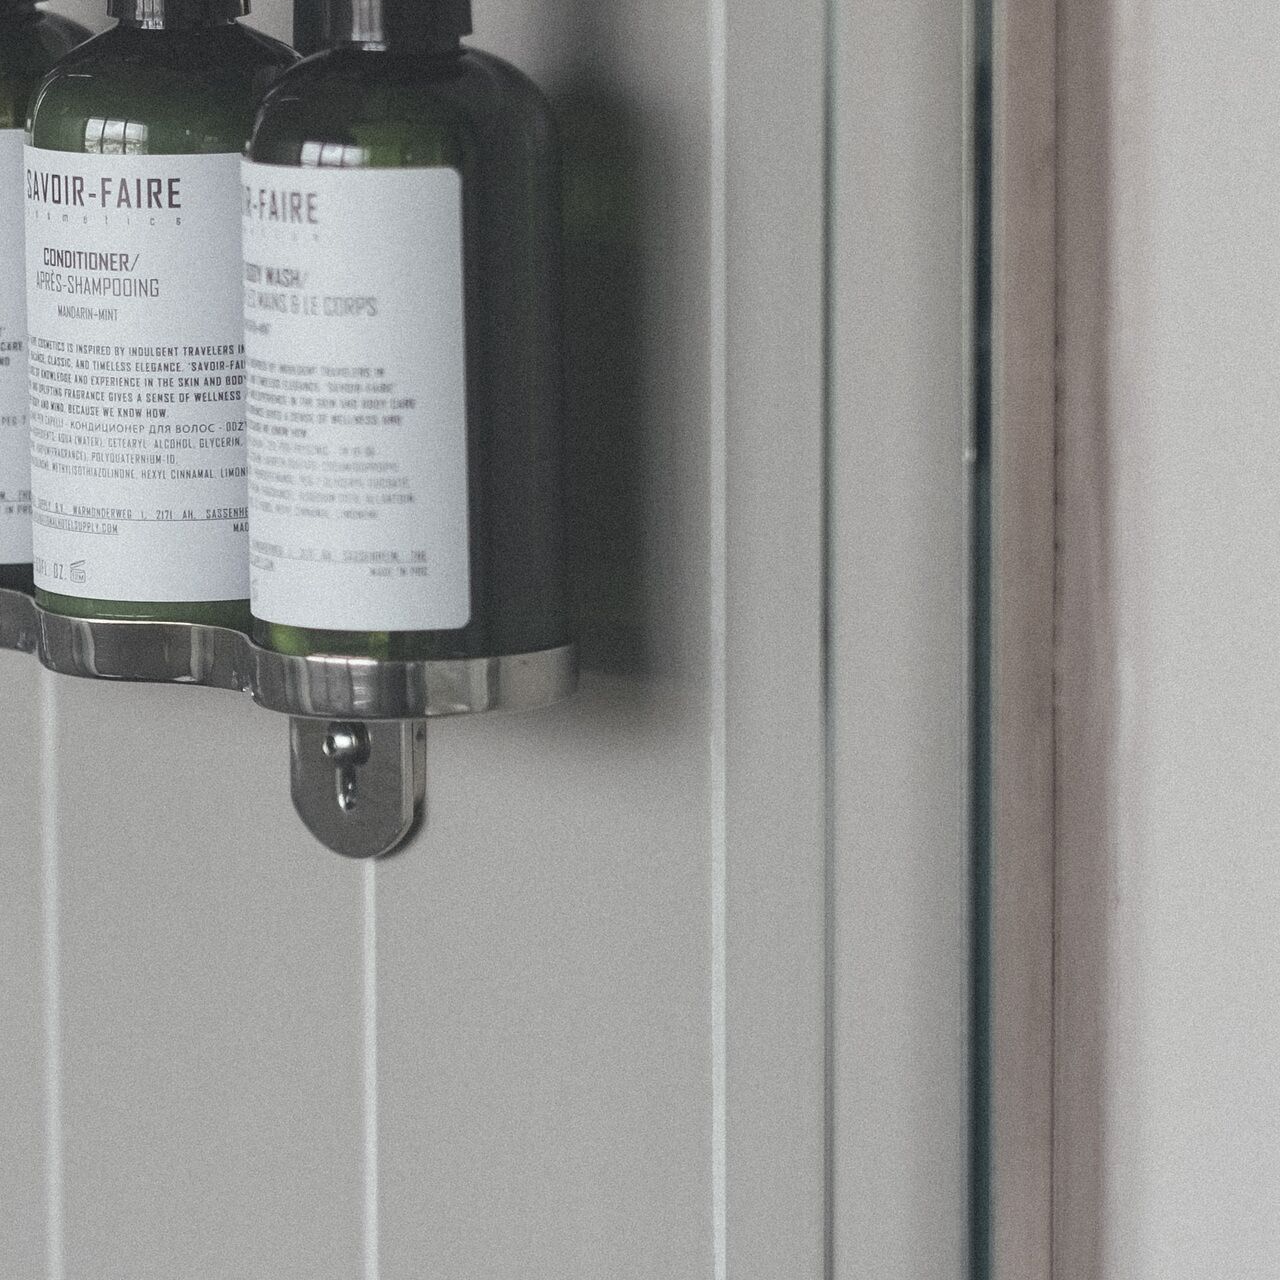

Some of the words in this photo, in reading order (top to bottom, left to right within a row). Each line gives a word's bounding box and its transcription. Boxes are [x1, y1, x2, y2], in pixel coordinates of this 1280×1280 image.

[26, 168, 182, 209] SAVOIR-FAIRE
[43, 247, 140, 272] CONDITIONER/
[36, 269, 160, 297] APRÈS-SHAMPOOING
[57, 305, 119, 321] MANDARIN-MINT
[76, 343, 111, 356] INSPIRED
[114, 346, 125, 356] BY
[128, 346, 178, 357] INDULGENT
[183, 344, 234, 356] TRAVELERS
[75, 359, 90, 370] AND
[92, 360, 132, 372] TIMELESS
[74, 374, 88, 385] AND
[90, 375, 141, 387] EXPERIENCE
[144, 377, 154, 387] IN
[157, 377, 174, 387] THE
[178, 377, 199, 387] SKIN
[203, 376, 222, 386] AND
[64, 388, 105, 401] FRAGRANCE
[108, 391, 133, 402] GIVES
[136, 393, 143, 402] A
[146, 392, 176, 403] SENSE
[178, 392, 190, 402] OF
[193, 390, 241, 402] WELLNESS
[67, 404, 99, 416] BECAUSE
[102, 407, 114, 417] WE
[117, 407, 142, 418] KNOW
[70, 420, 145, 434] КОНДИЦИОНЕР
[148, 424, 171, 435] ДЛЯ
[175, 423, 216, 434] ВОЛОС
[108, 438, 147, 449] CETEARYL
[141, 469, 166, 480] HEXYL
[73, 505, 132, 519] WARMONDERWEG
